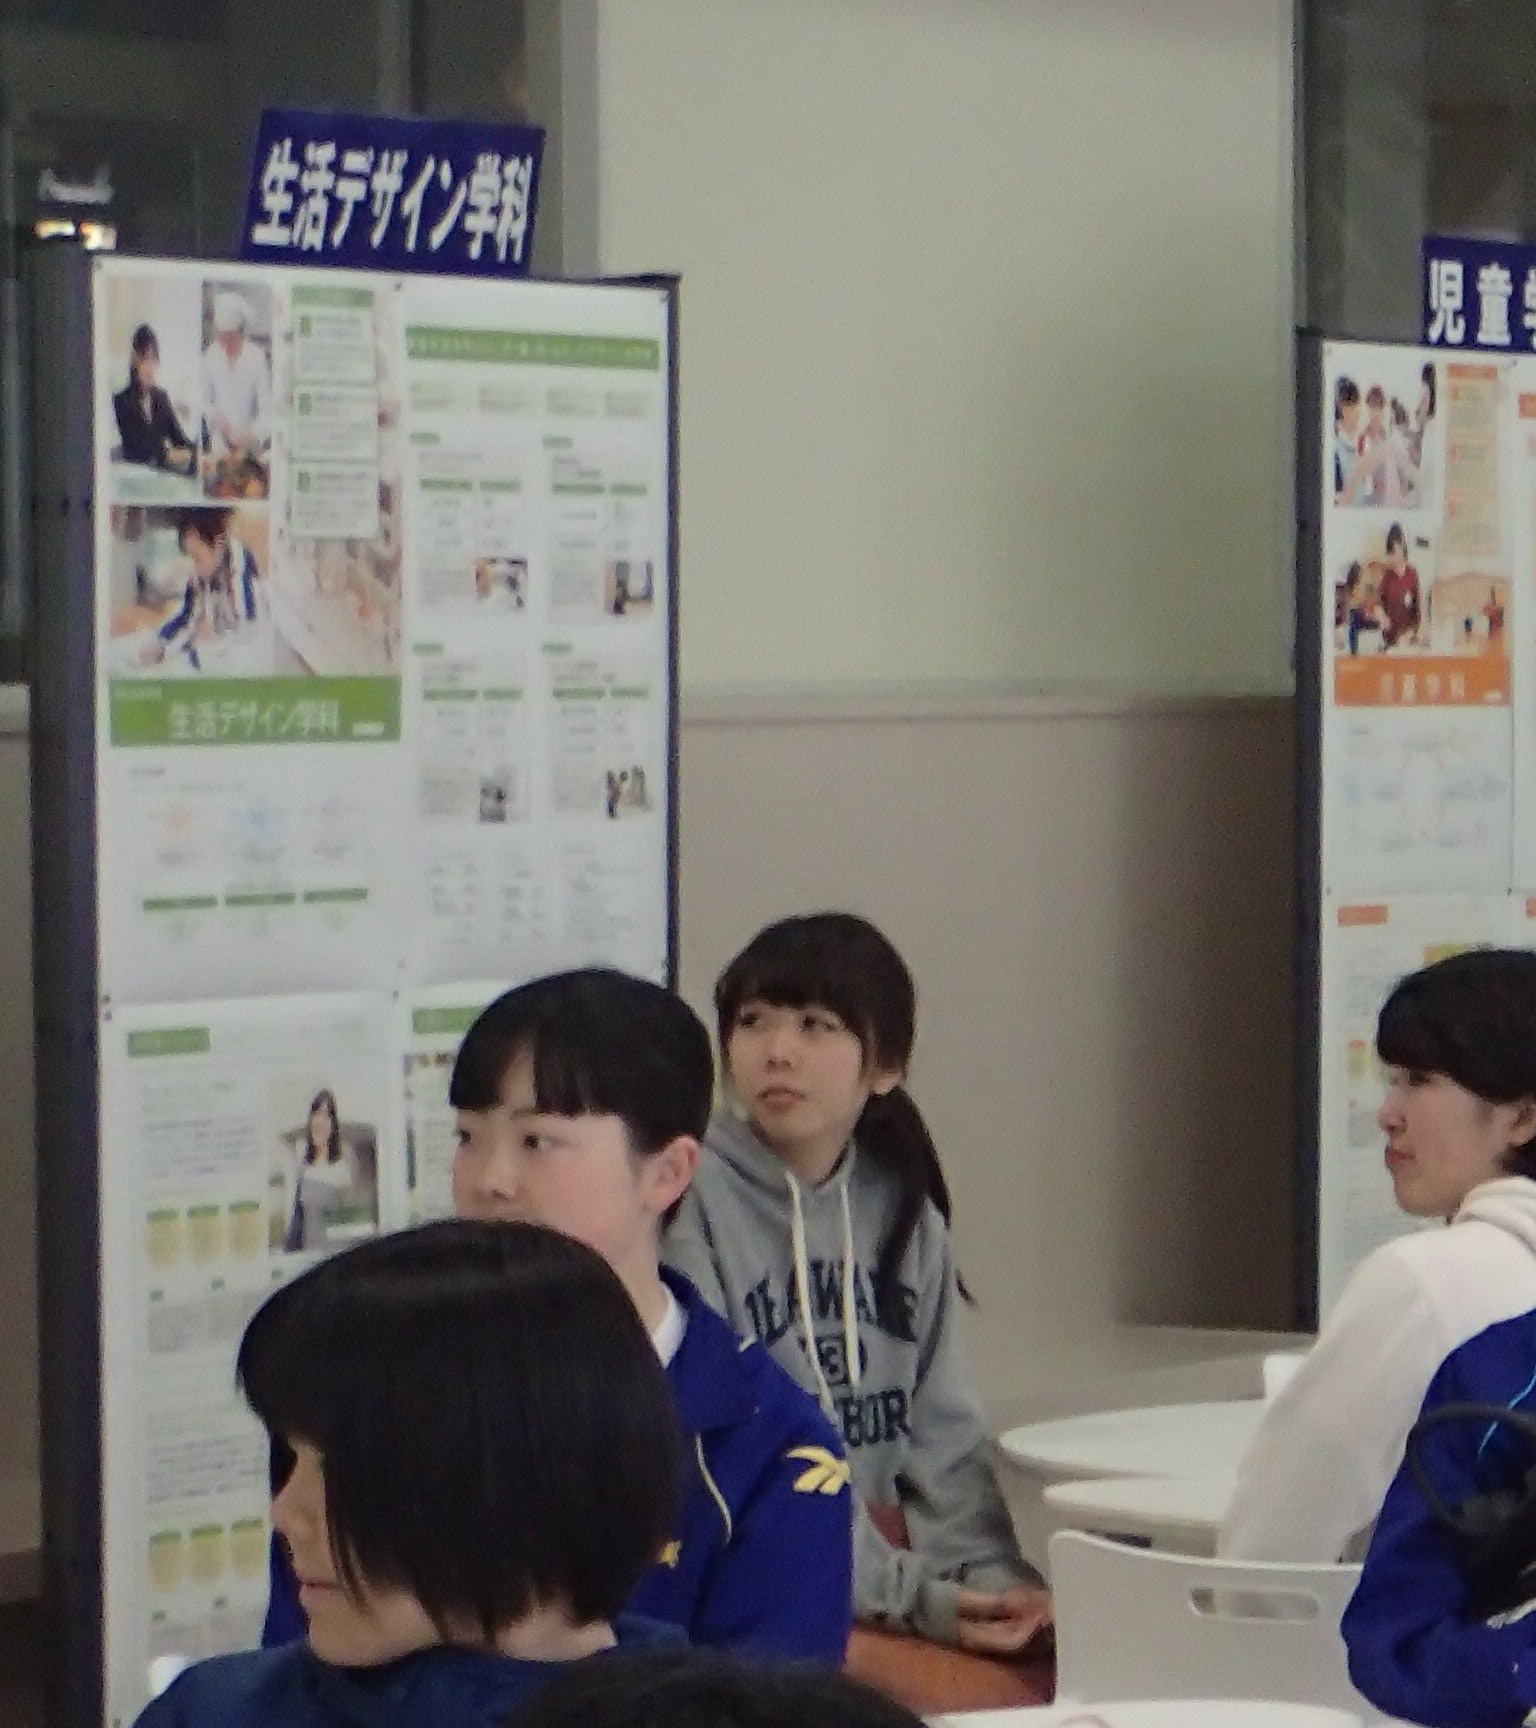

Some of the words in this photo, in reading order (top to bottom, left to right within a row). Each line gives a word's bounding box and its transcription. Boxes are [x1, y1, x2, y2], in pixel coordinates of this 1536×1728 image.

[251, 136, 533, 265] 生活デザイン学科
